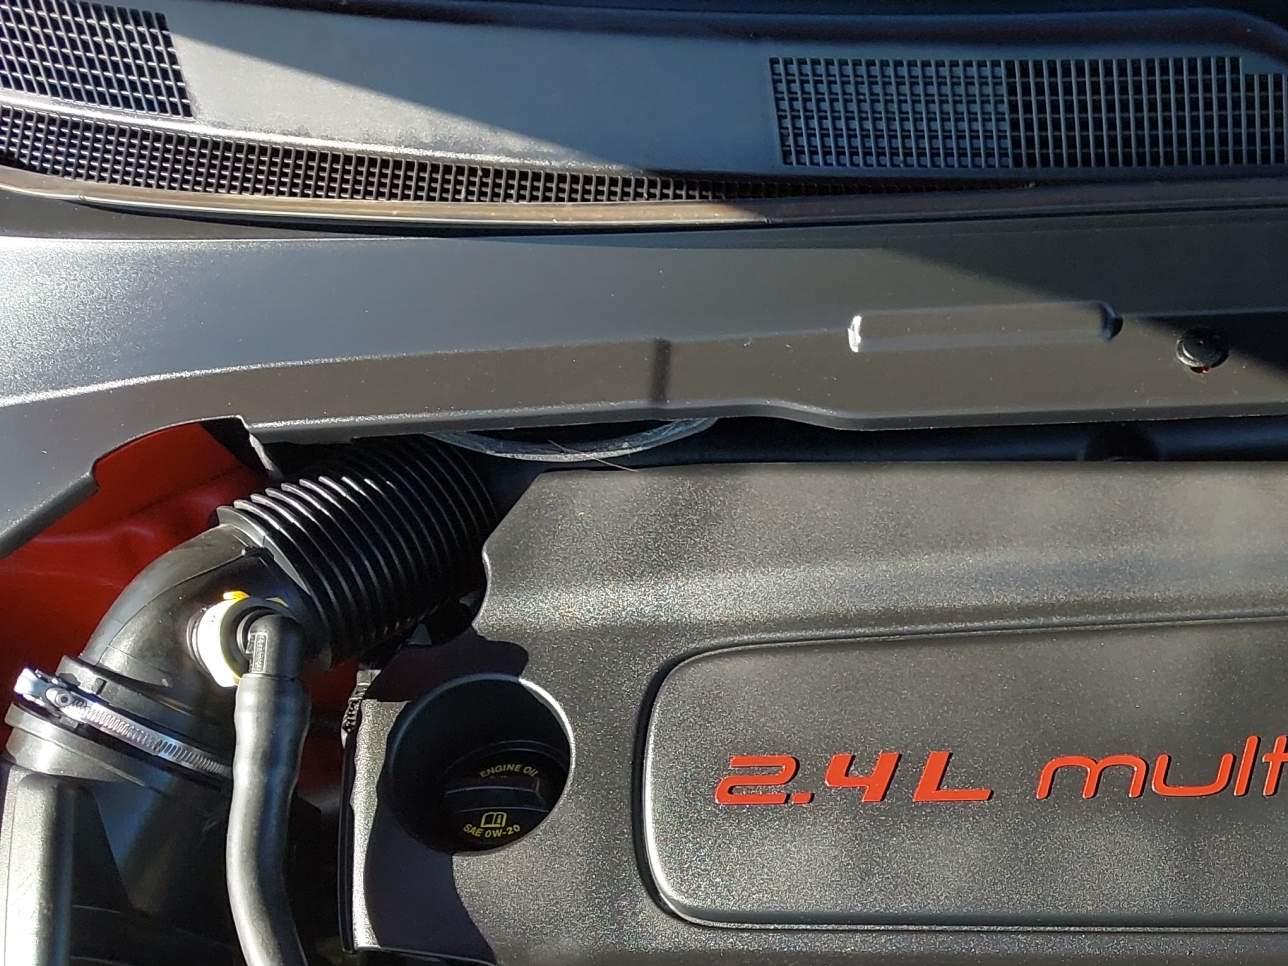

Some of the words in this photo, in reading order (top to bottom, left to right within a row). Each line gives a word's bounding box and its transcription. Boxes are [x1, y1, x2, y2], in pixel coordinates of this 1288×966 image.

[480, 763, 521, 777] ENGINE
[463, 823, 483, 837] SAE
[484, 824, 521, 838] 0W-20
